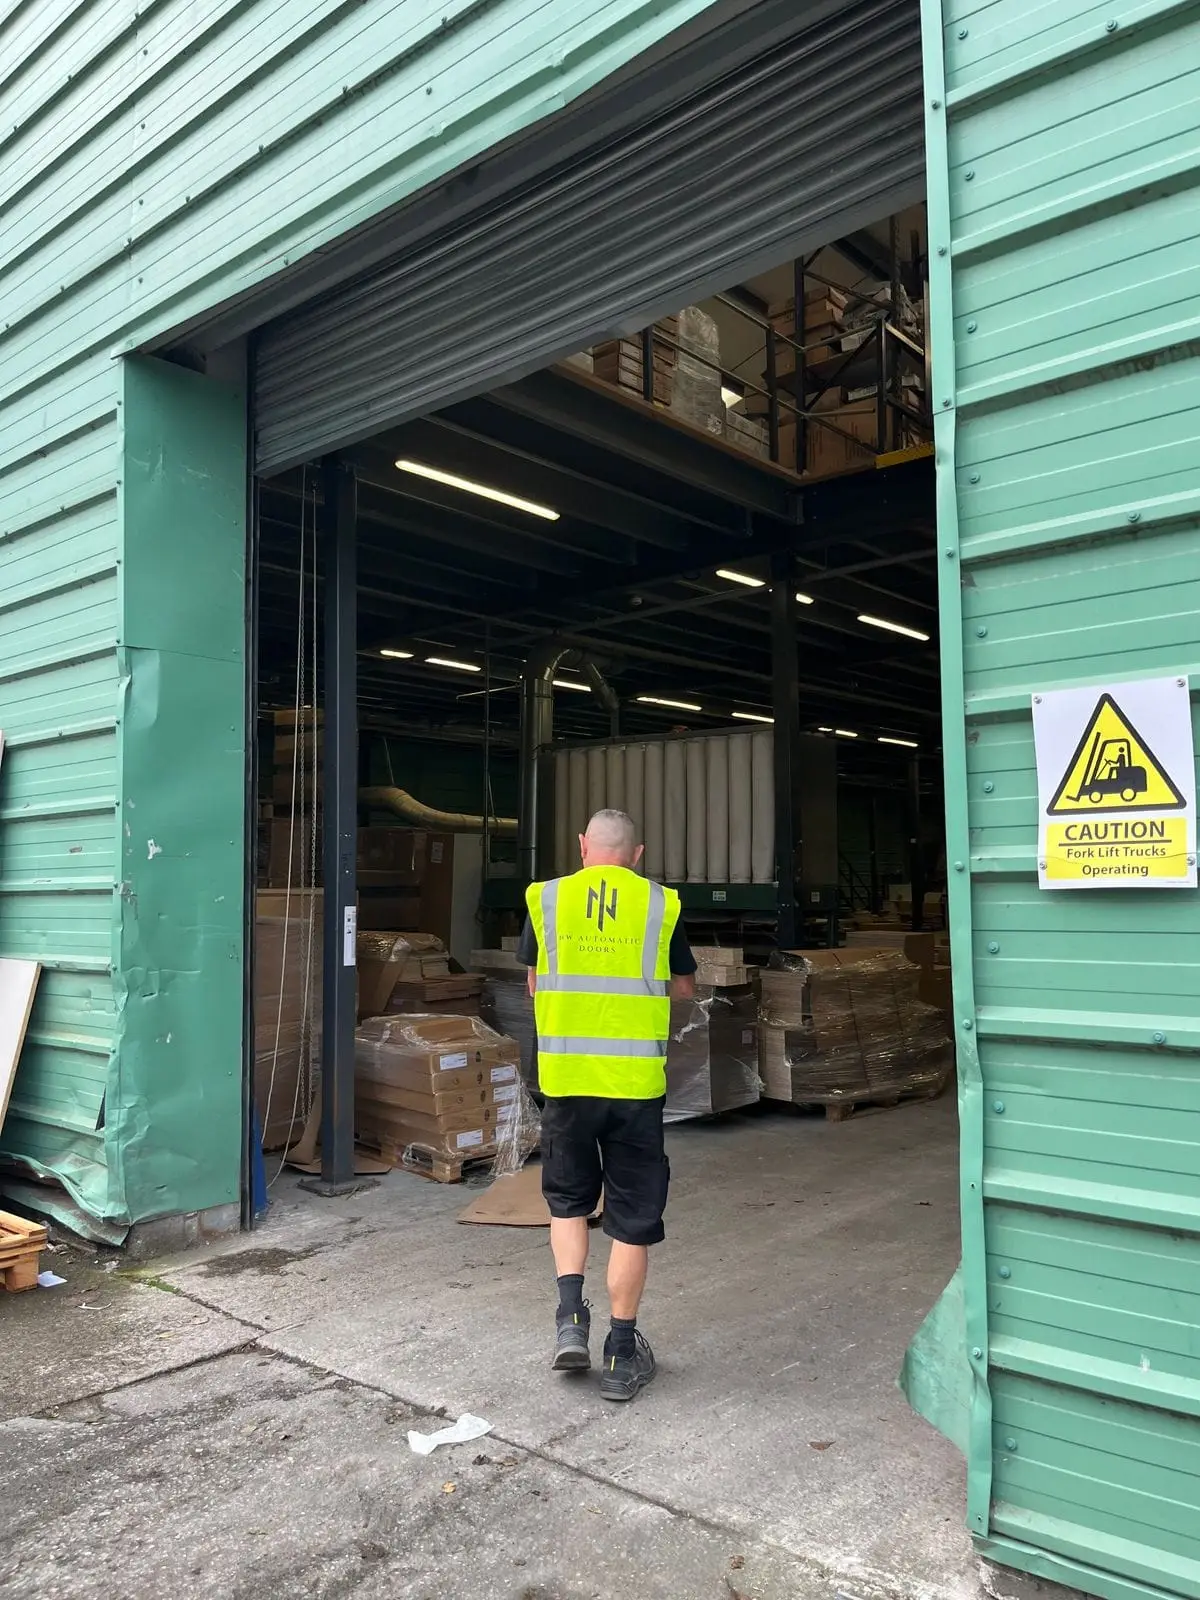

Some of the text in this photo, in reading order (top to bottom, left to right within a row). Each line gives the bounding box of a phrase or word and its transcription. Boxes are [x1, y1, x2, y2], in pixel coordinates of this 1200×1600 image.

[1065, 820, 1165, 841] CAUTION
[1066, 845, 1166, 859] Fork Lift Trucks
[1082, 864, 1149, 877] Operating
[578, 935, 640, 945] AUTOMATIC
[578, 945, 616, 953] DOORS
